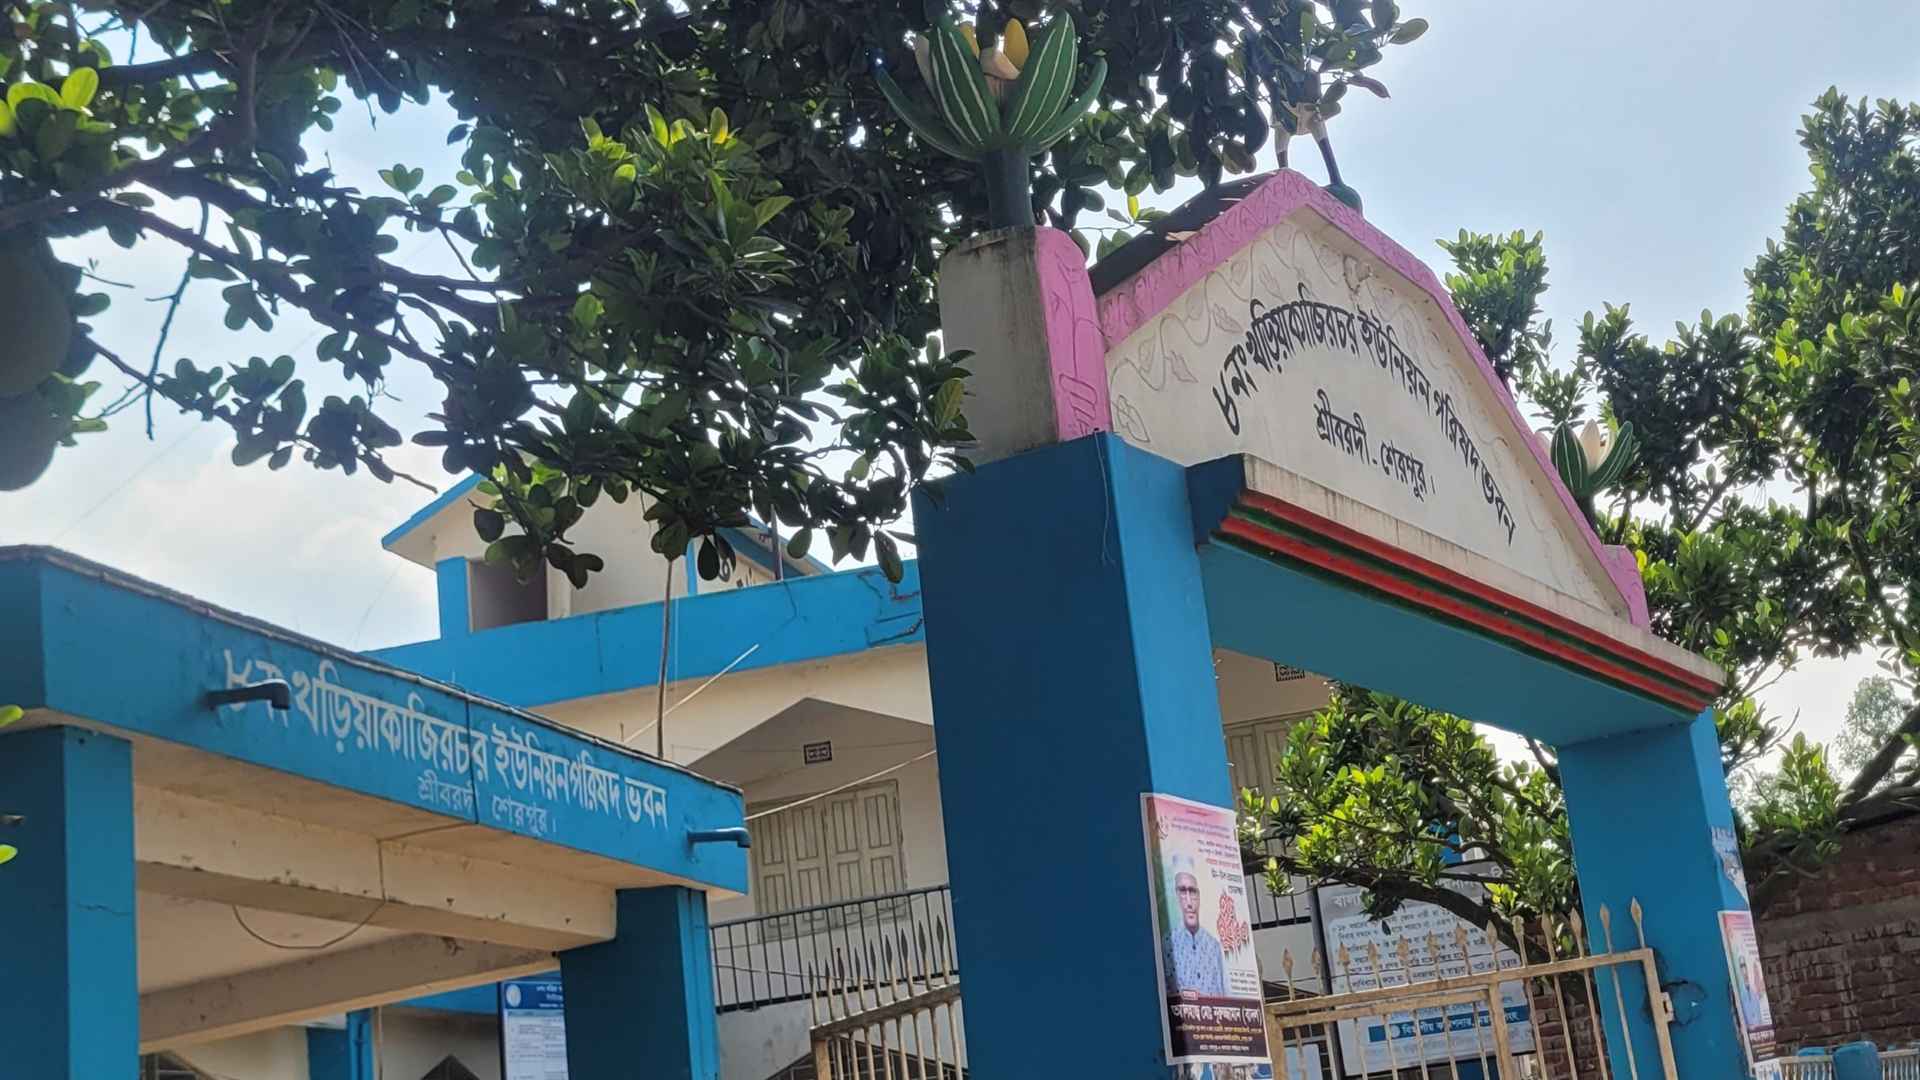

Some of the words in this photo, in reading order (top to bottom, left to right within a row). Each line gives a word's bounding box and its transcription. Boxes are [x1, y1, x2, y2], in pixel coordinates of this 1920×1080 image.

[1357, 306, 1431, 415] ইউনিয়ন
[1434, 389, 1481, 480] পরিষদ
[1481, 459, 1517, 546] ভবন
[624, 776, 669, 829] ভবন
